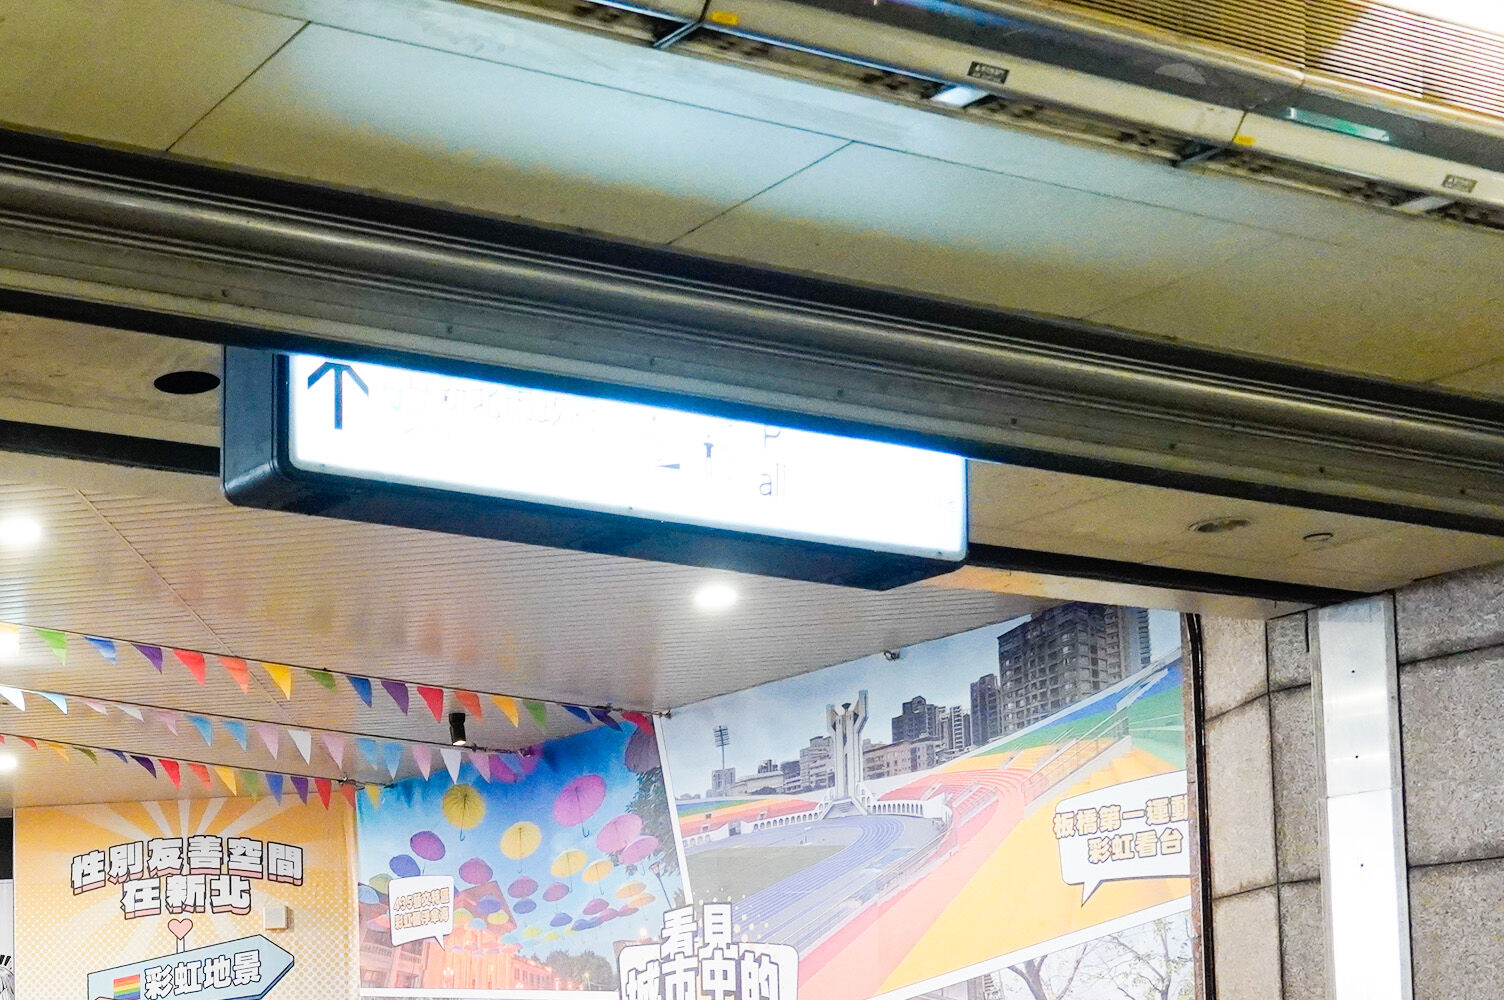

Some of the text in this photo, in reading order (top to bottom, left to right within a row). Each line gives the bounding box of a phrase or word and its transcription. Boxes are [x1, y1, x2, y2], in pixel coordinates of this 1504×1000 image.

[71, 834, 304, 895] 性別友善空間
[1086, 827, 1183, 864] 彩虹看台
[120, 874, 251, 920] 在新北
[660, 902, 739, 960] 看見
[144, 949, 261, 1000] 彩虹地景
